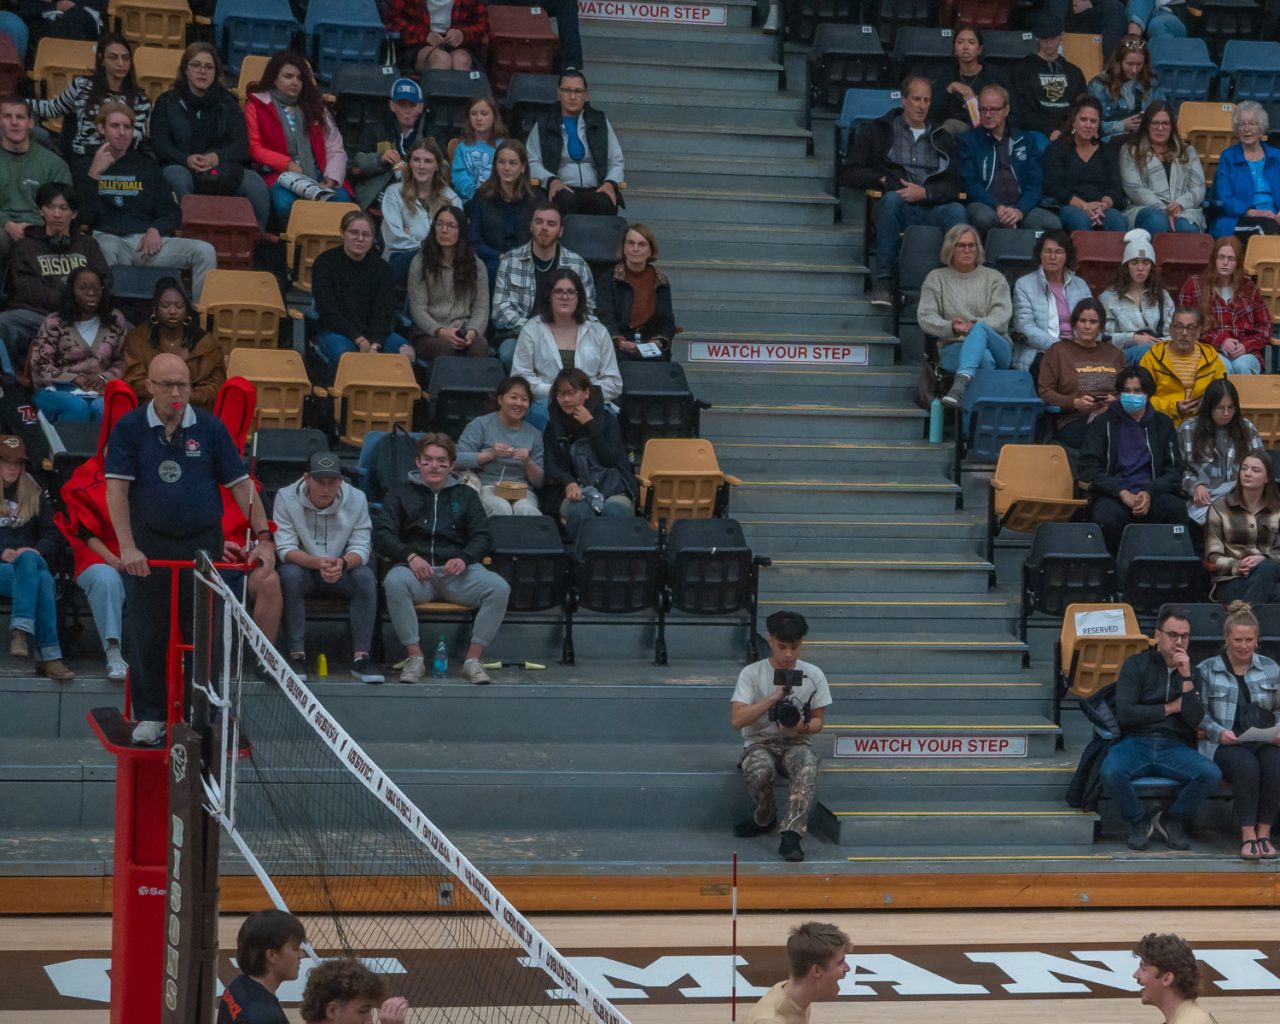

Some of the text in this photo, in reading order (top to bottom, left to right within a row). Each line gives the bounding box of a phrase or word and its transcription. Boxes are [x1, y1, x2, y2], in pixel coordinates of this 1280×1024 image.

[578, 2, 711, 20] WATCH YOUR STEP
[38, 258, 87, 277] BISONS
[707, 344, 852, 360] WATCH YOUR STEP
[1083, 625, 1119, 635] RESERVED
[854, 739, 1009, 753] WATCH YOUR STEP
